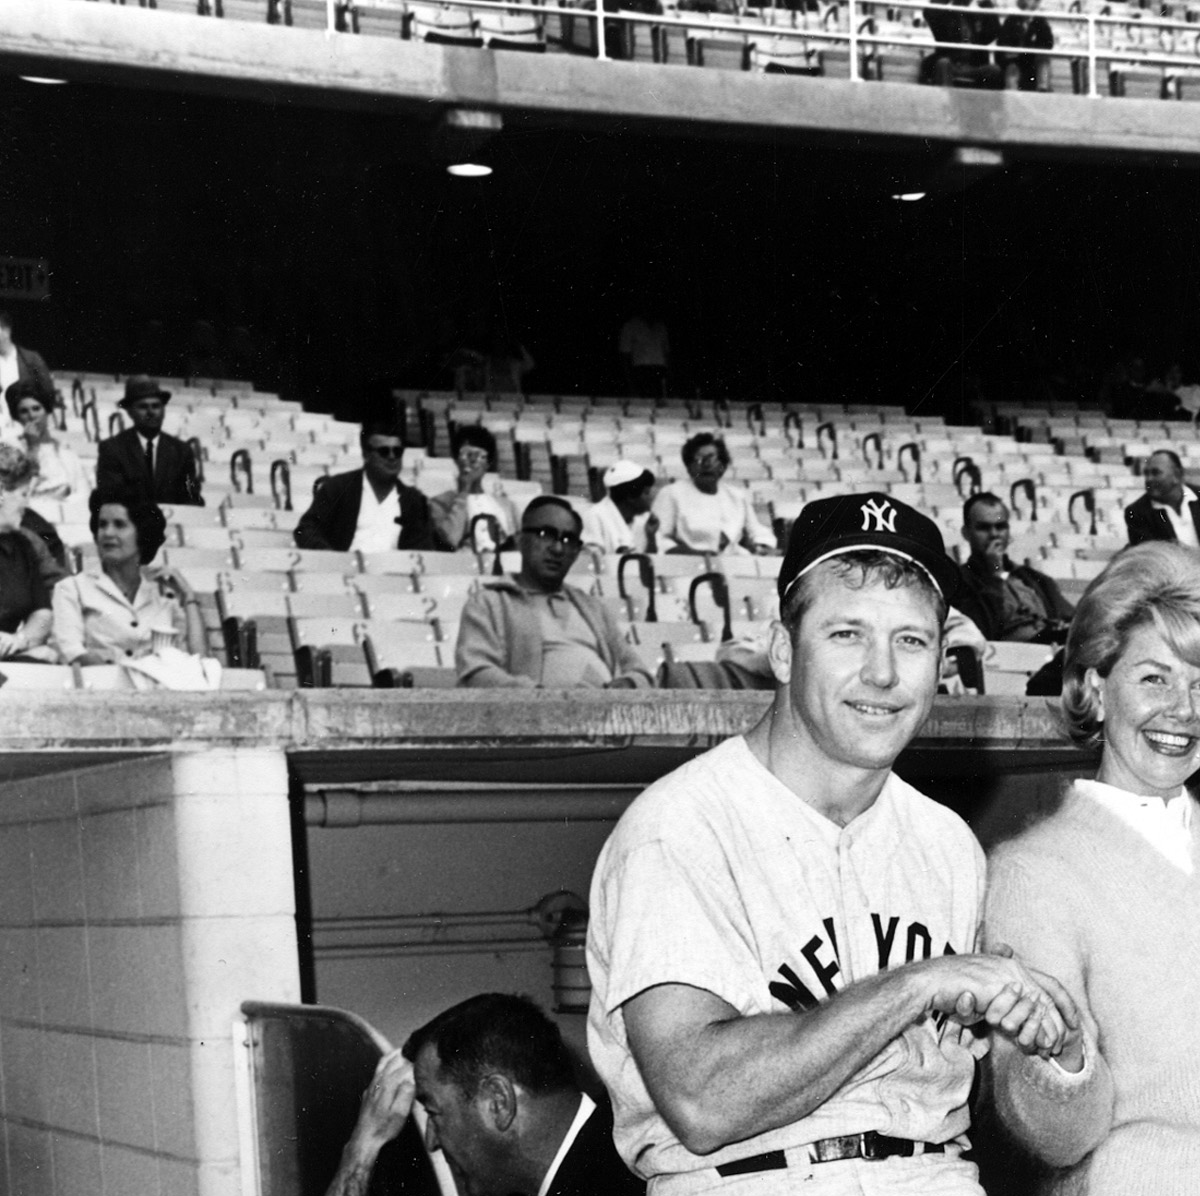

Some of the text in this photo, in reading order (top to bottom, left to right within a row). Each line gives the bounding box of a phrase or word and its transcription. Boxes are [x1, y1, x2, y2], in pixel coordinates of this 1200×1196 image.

[0, 263, 34, 291] XIT
[860, 498, 897, 533] NY
[869, 912, 957, 968] YO
